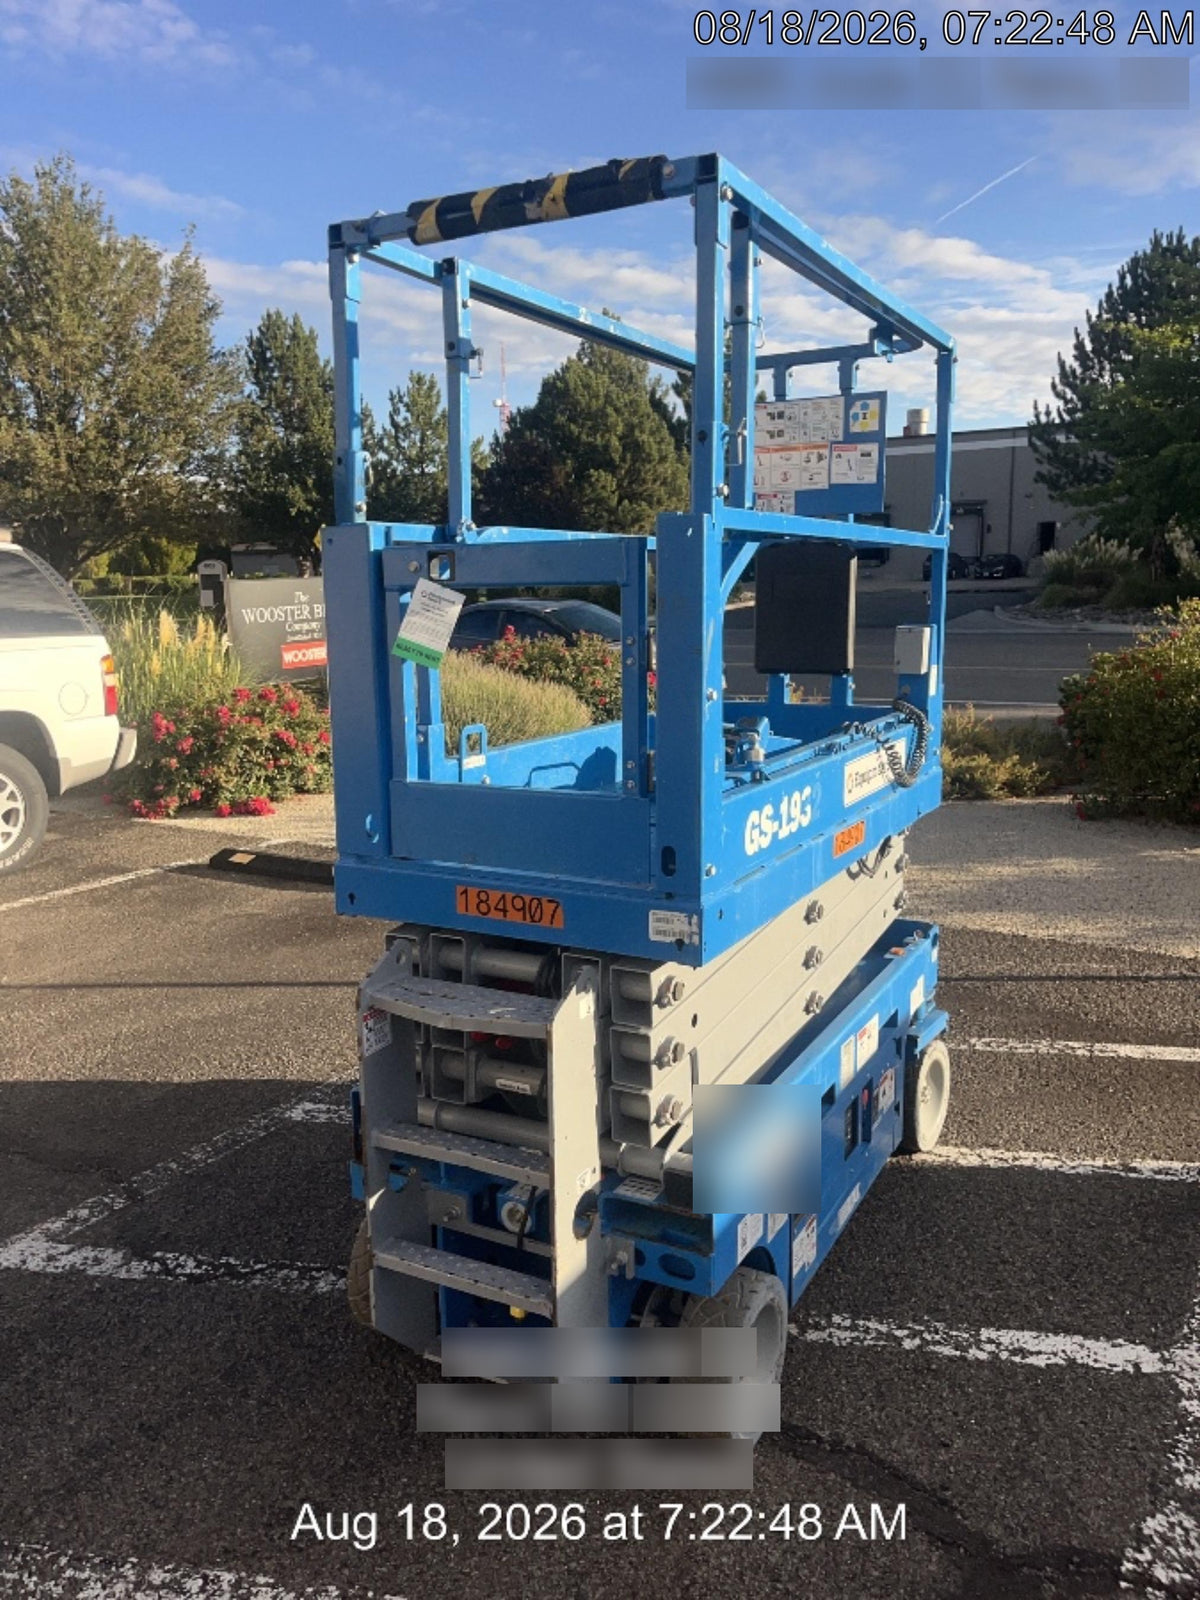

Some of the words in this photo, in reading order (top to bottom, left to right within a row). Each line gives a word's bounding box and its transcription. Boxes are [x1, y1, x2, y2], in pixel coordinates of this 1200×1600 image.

[294, 591, 310, 603] The
[241, 604, 311, 624] WOOSTER
[459, 887, 560, 925] 184907
